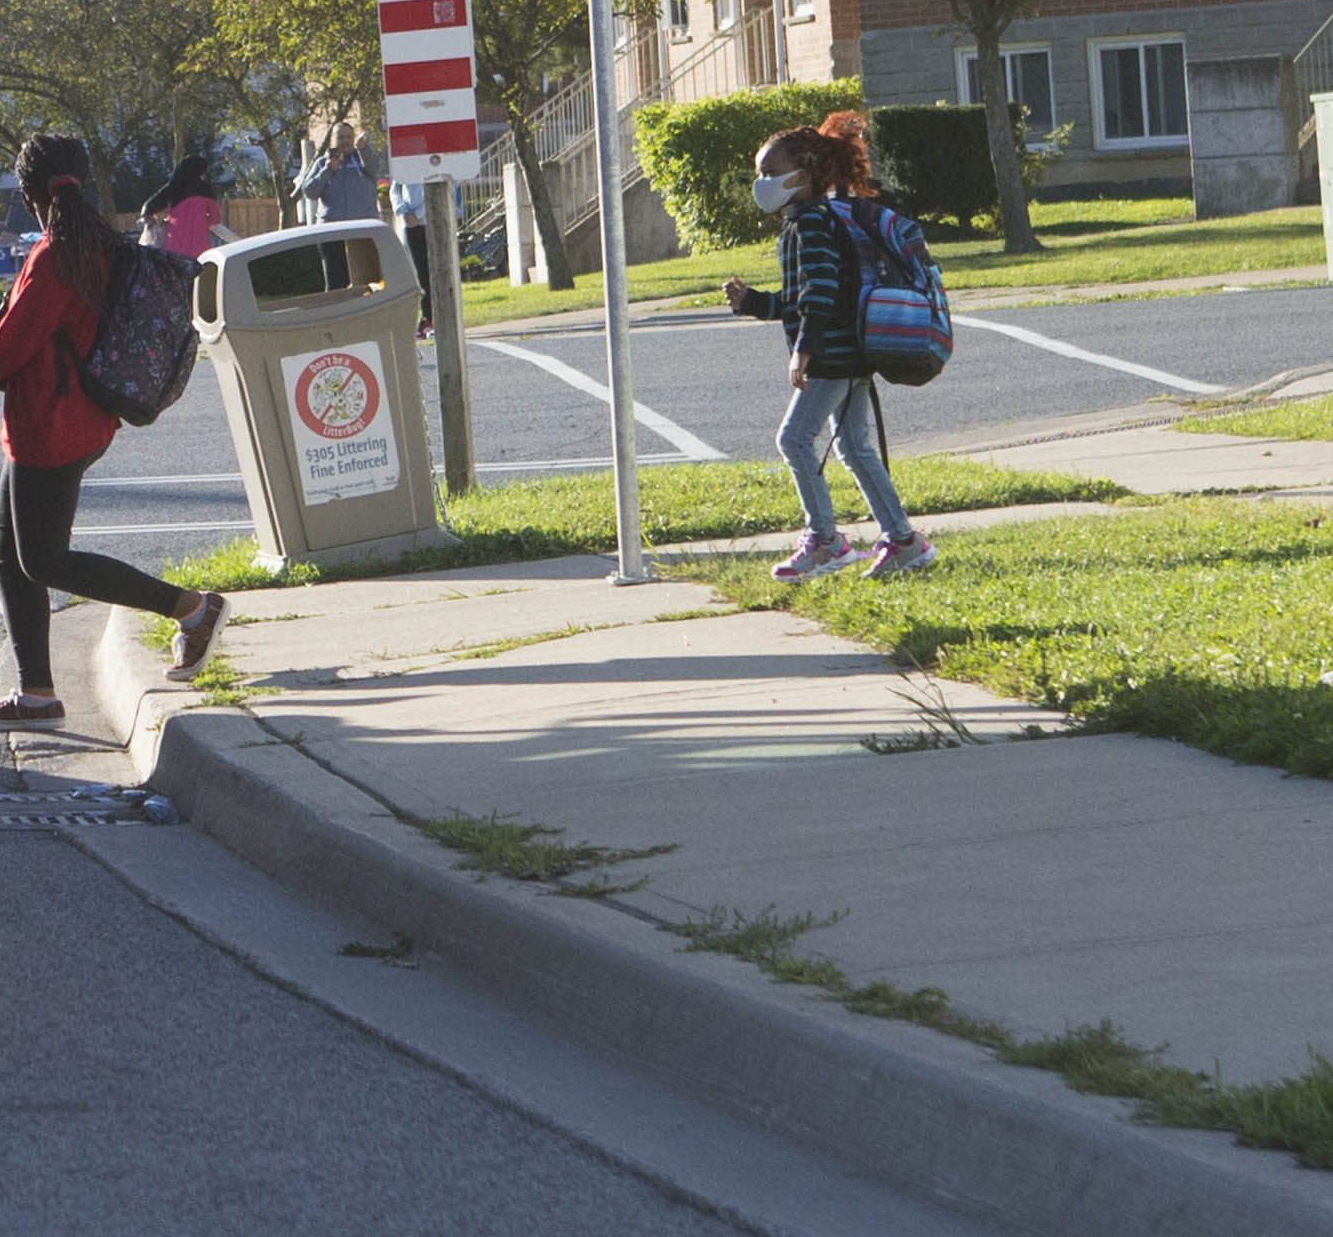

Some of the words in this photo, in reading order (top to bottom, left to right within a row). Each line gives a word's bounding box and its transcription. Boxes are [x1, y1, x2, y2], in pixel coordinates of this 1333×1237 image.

[305, 446, 335, 463] $305
[336, 437, 387, 457] Littering
[310, 465, 335, 479] Fine
[337, 452, 388, 474] Enforced
